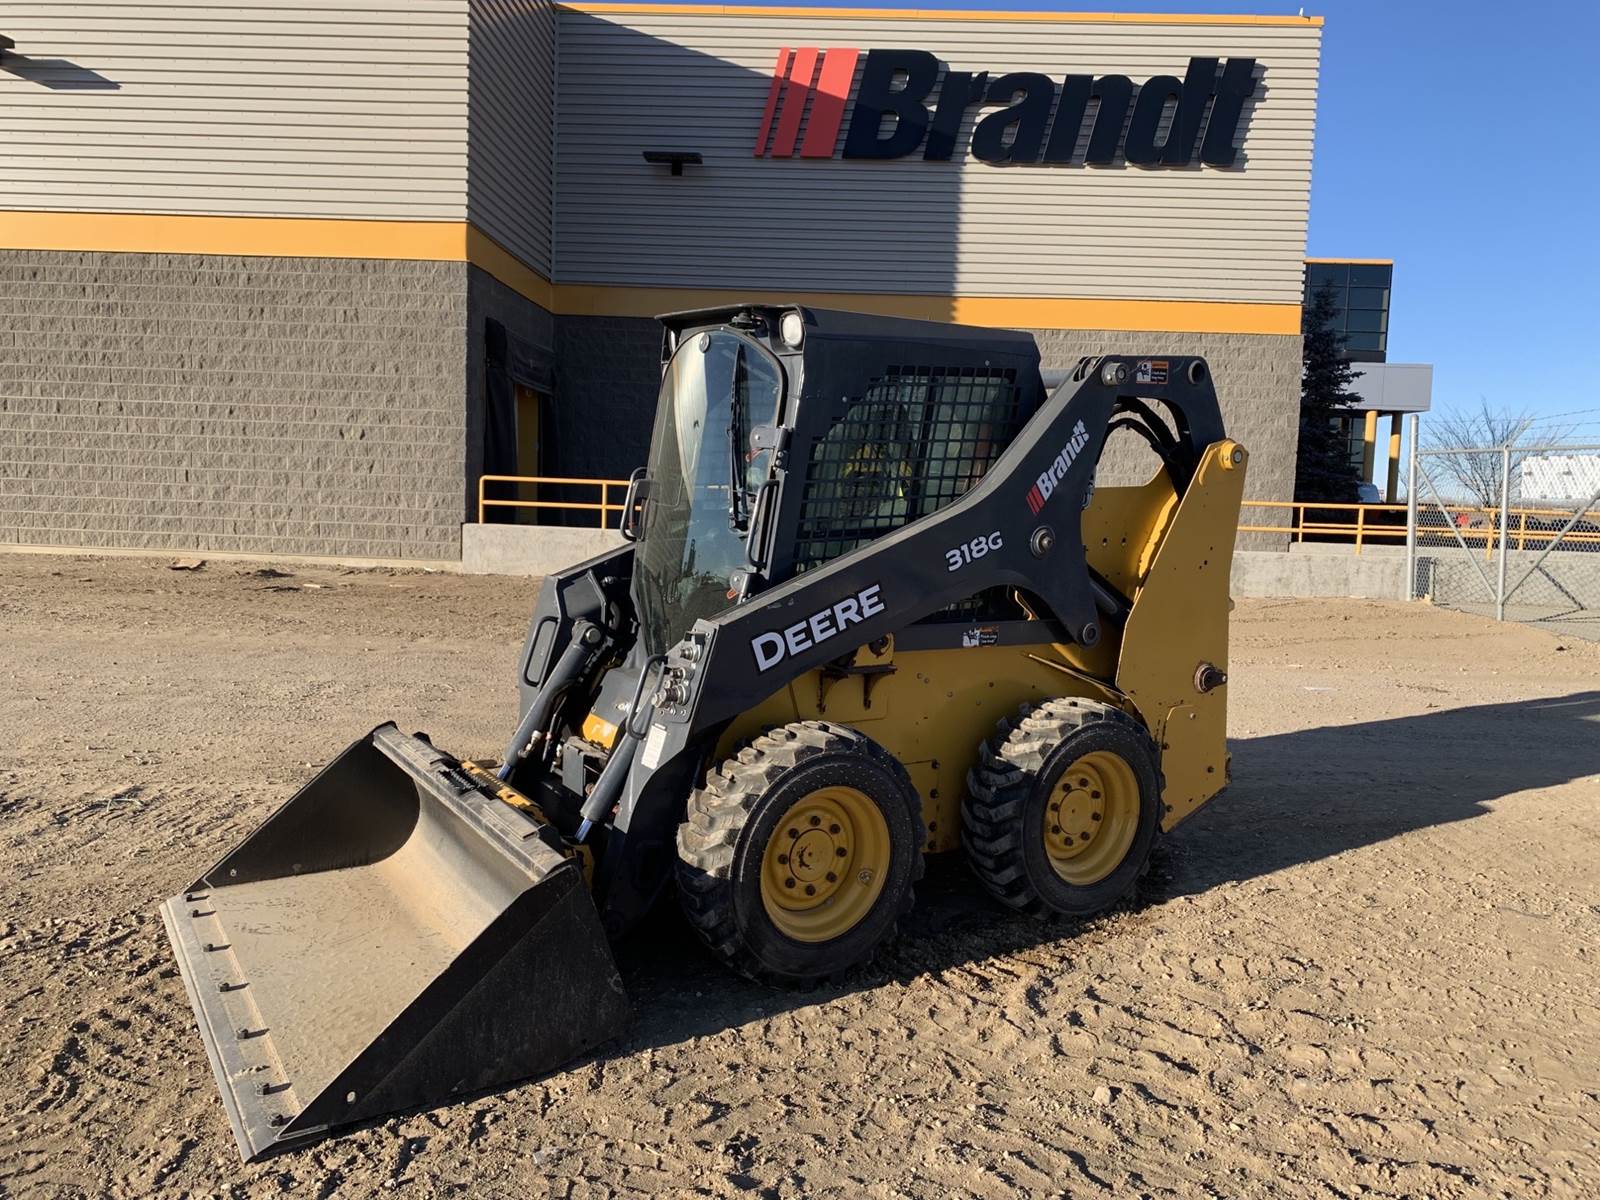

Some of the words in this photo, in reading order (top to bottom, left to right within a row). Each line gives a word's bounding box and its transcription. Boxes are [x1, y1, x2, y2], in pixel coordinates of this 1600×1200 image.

[842, 48, 1256, 168] Brandt
[1036, 419, 1090, 502] Brandt
[945, 530, 1003, 572] 318G
[751, 584, 885, 673] DEERE
